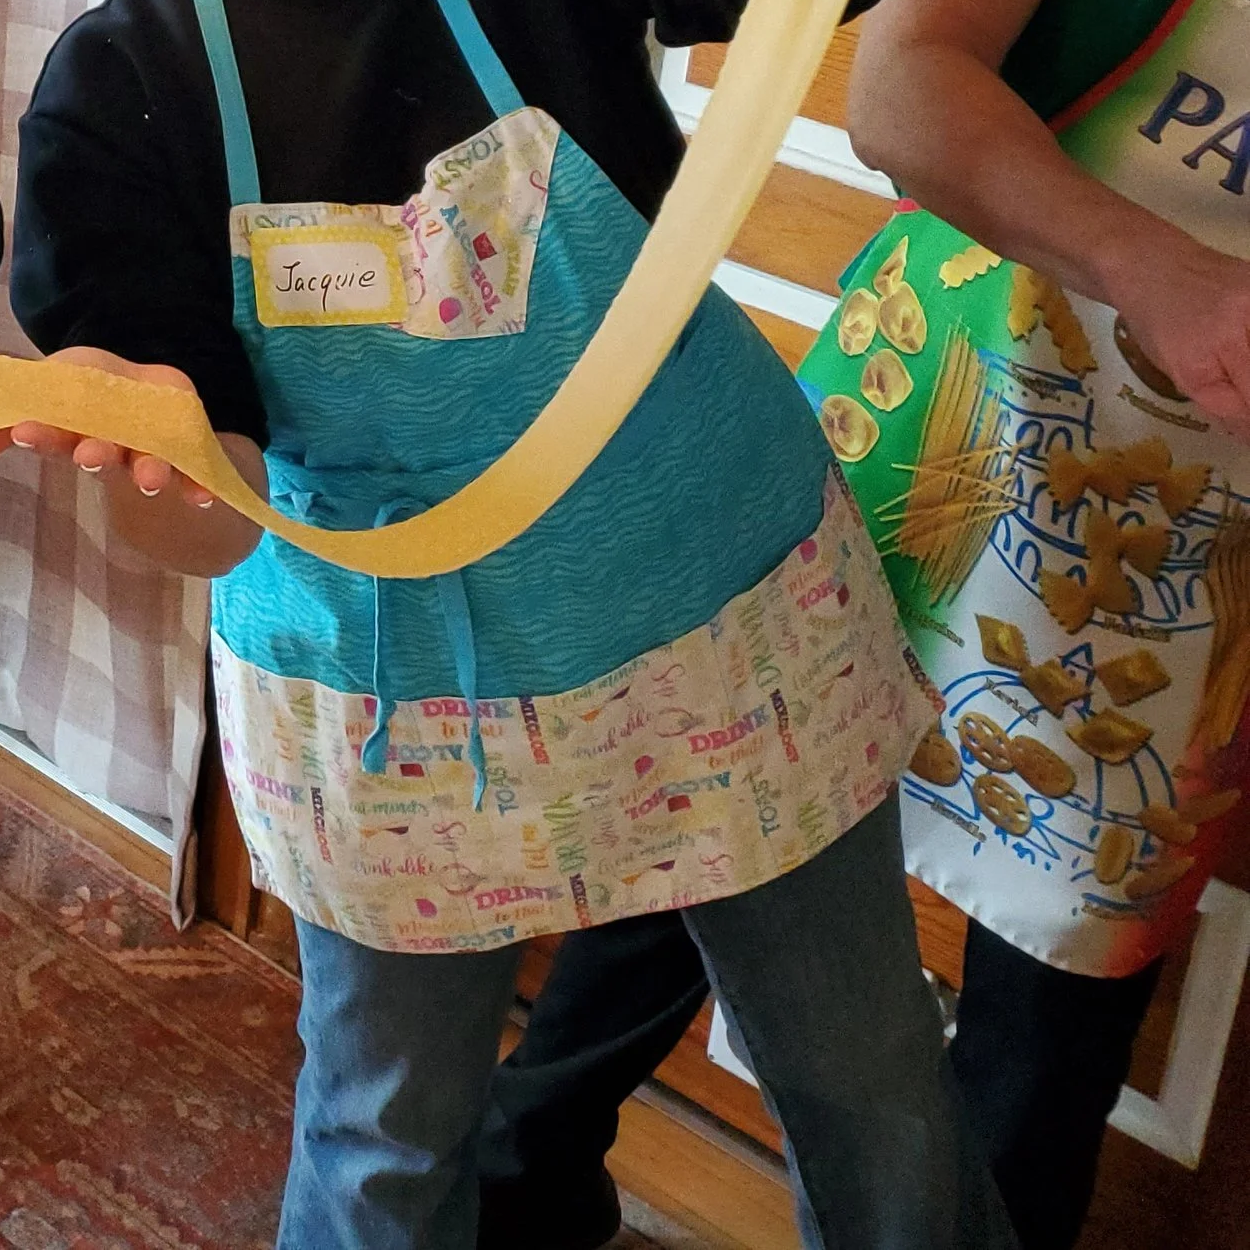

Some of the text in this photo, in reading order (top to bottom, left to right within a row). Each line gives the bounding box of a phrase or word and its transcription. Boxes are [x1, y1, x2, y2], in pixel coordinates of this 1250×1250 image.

[433, 131, 503, 189] TOAST
[276, 261, 376, 312] Jacquie
[688, 704, 770, 754] DRINK
[474, 886, 563, 910] DRINK
